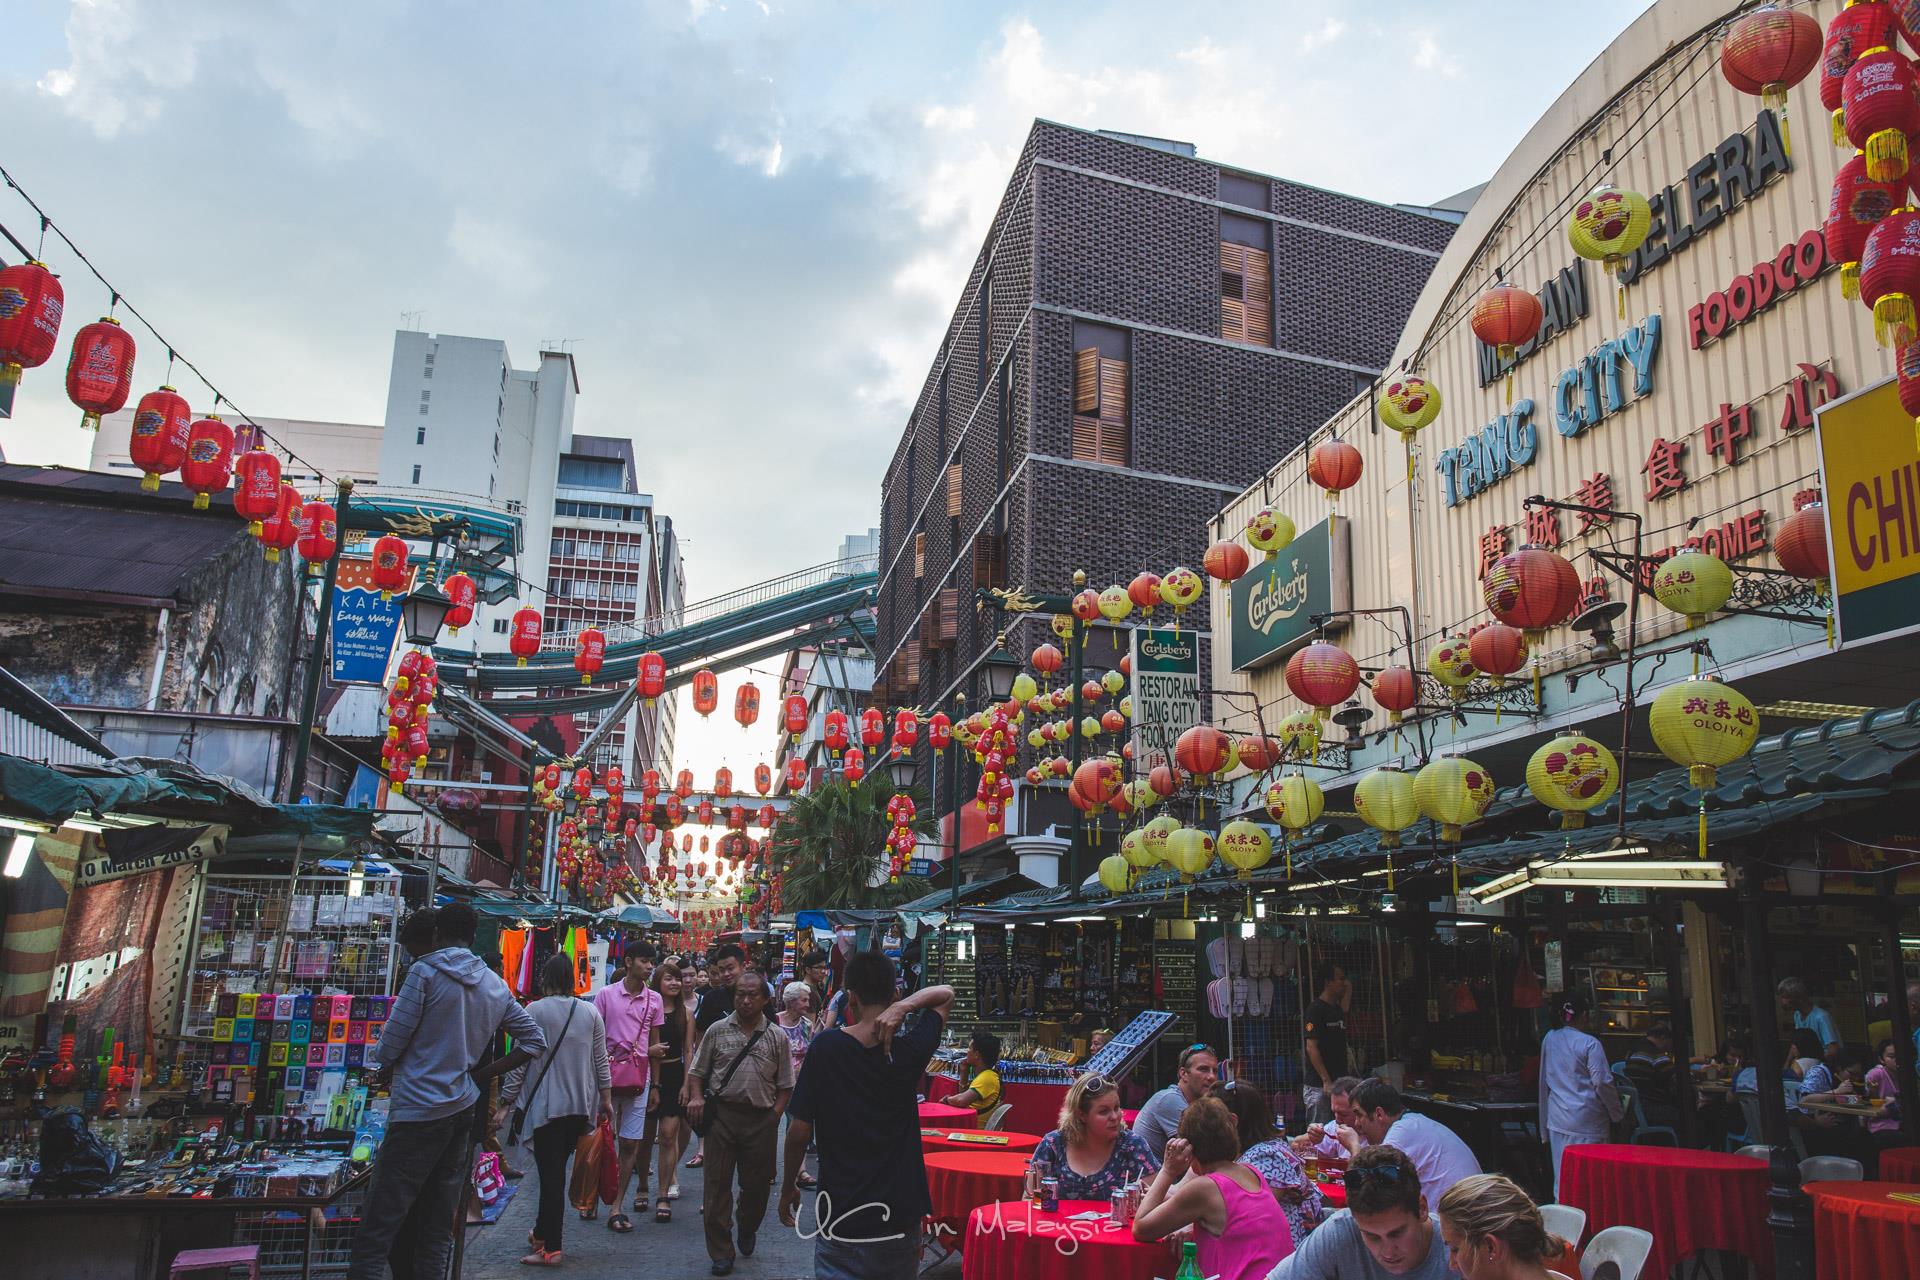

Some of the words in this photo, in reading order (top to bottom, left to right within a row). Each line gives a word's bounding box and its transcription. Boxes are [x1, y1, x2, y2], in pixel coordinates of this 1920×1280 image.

[1477, 256, 1588, 388] MAN
[1551, 315, 1661, 438] CITY
[1847, 460, 1920, 572] CHI
[341, 595, 393, 612] KAFE
[1248, 568, 1308, 632] Carlsberg
[1141, 639, 1192, 659] Carlsberg
[1140, 675, 1196, 699] RESTORAN
[1142, 700, 1169, 723] TANG
[1172, 702, 1195, 724] CITY
[1683, 697, 1753, 726] 我来也
[1141, 725, 1165, 748] FOOD
[1694, 719, 1744, 738] OLOIYA
[1225, 832, 1262, 846] 我来也
[101, 855, 155, 875] March
[161, 845, 202, 865] 2013
